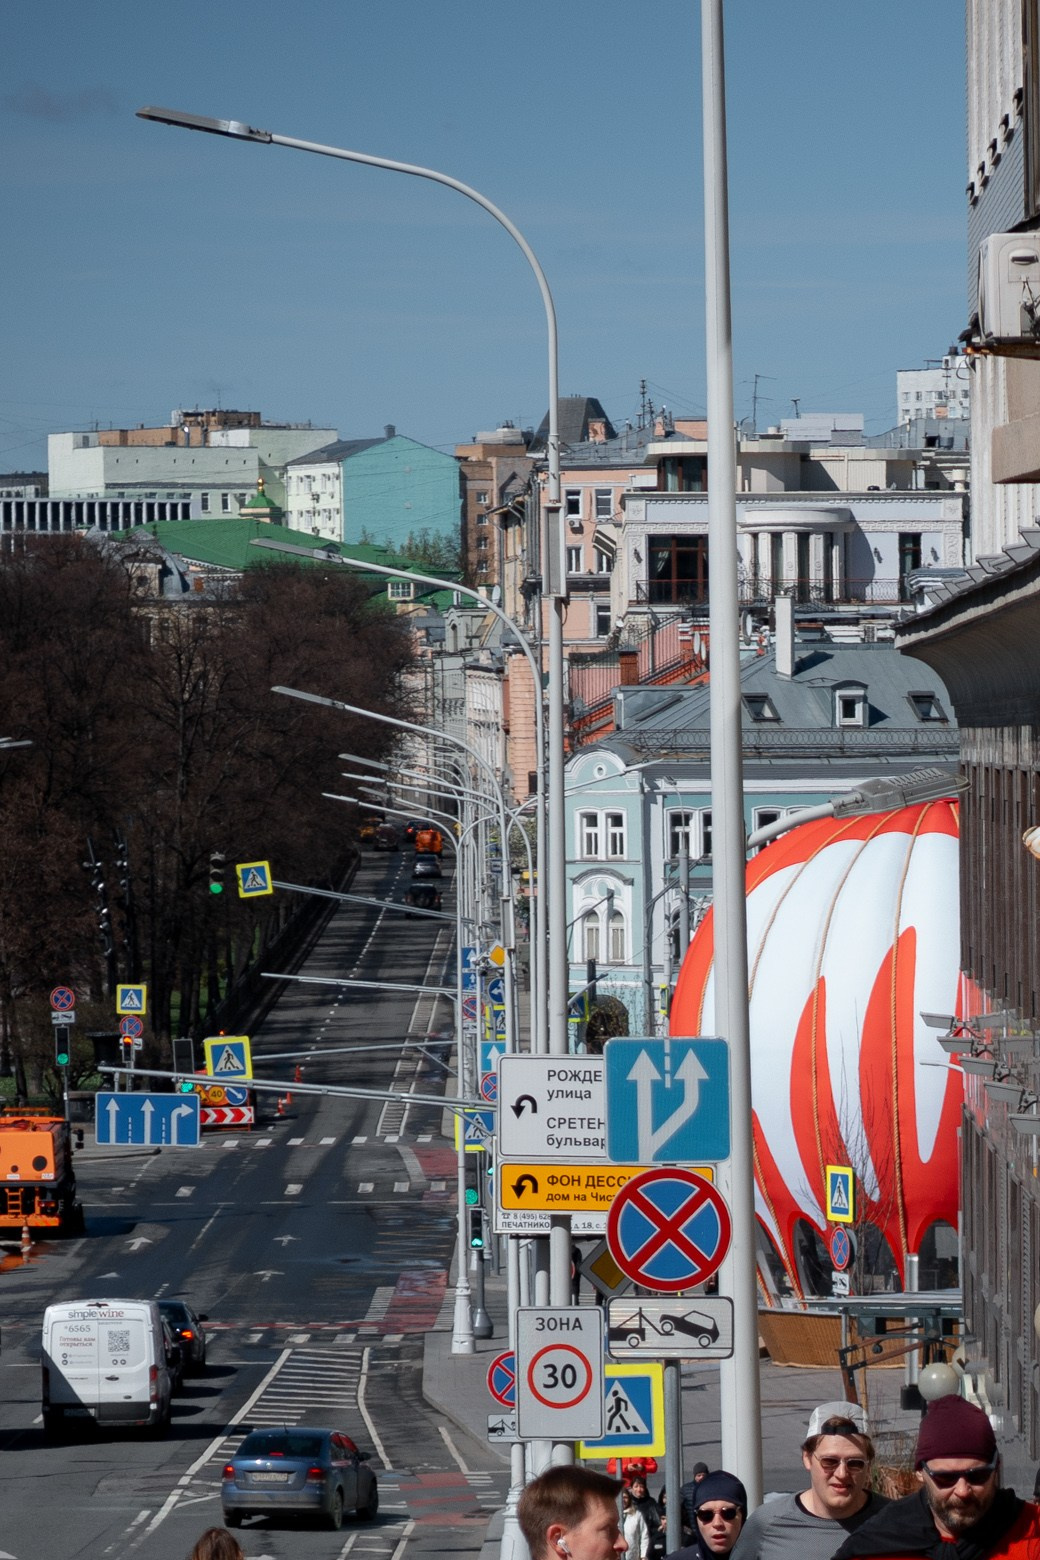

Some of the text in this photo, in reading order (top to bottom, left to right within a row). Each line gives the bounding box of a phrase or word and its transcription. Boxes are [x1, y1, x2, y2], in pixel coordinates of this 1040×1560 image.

[547, 1069, 603, 1084] РОЖДЕ
[210, 1090, 222, 1098] 40
[546, 1089, 592, 1101] улица
[546, 1174, 631, 1189] ФОН ДЕСС
[545, 1193, 572, 1203] дом
[573, 1193, 587, 1202] на
[519, 1213, 538, 1221] (495)
[535, 1317, 583, 1332] ЗОНА
[542, 1363, 577, 1389] 30
